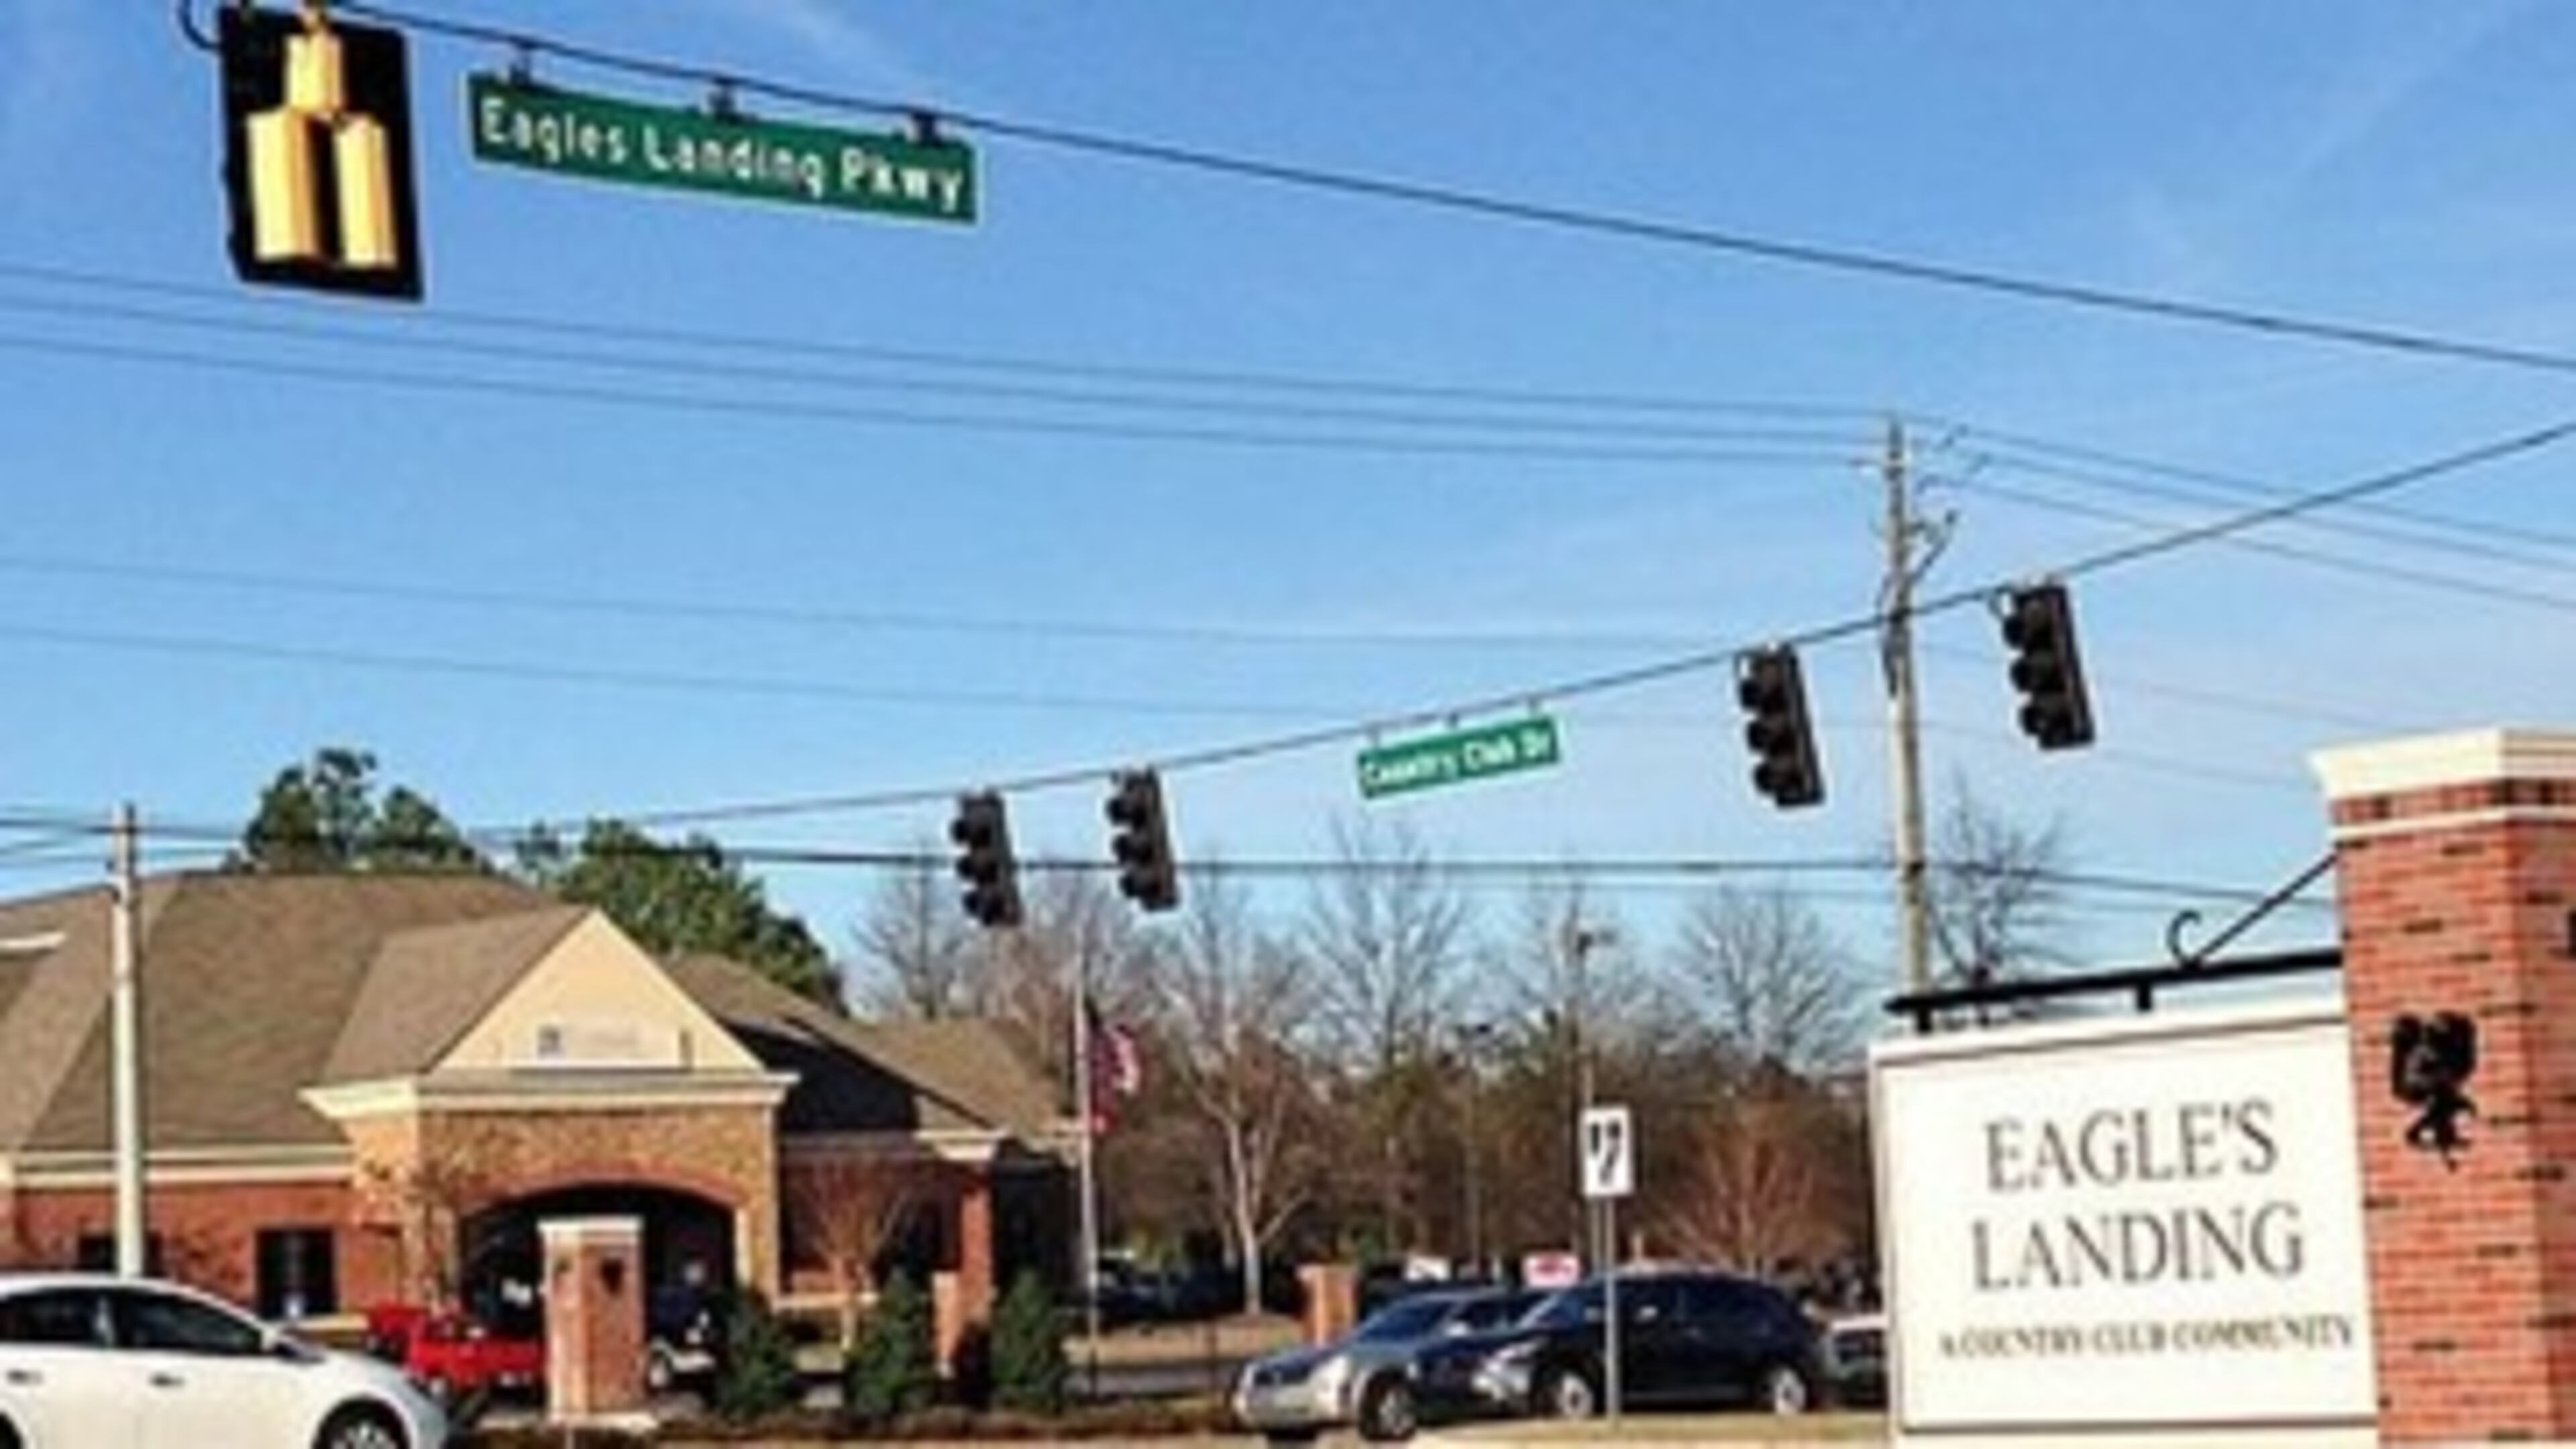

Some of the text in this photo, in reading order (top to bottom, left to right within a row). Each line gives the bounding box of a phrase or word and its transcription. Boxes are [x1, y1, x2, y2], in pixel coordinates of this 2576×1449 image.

[479, 97, 966, 213] Eagles Landing Pkwy
[1984, 1096, 2278, 1193] EAGLE'S
[1971, 1202, 2304, 1291] LANDING
[2172, 1313, 2353, 1350] COMMUNITY
